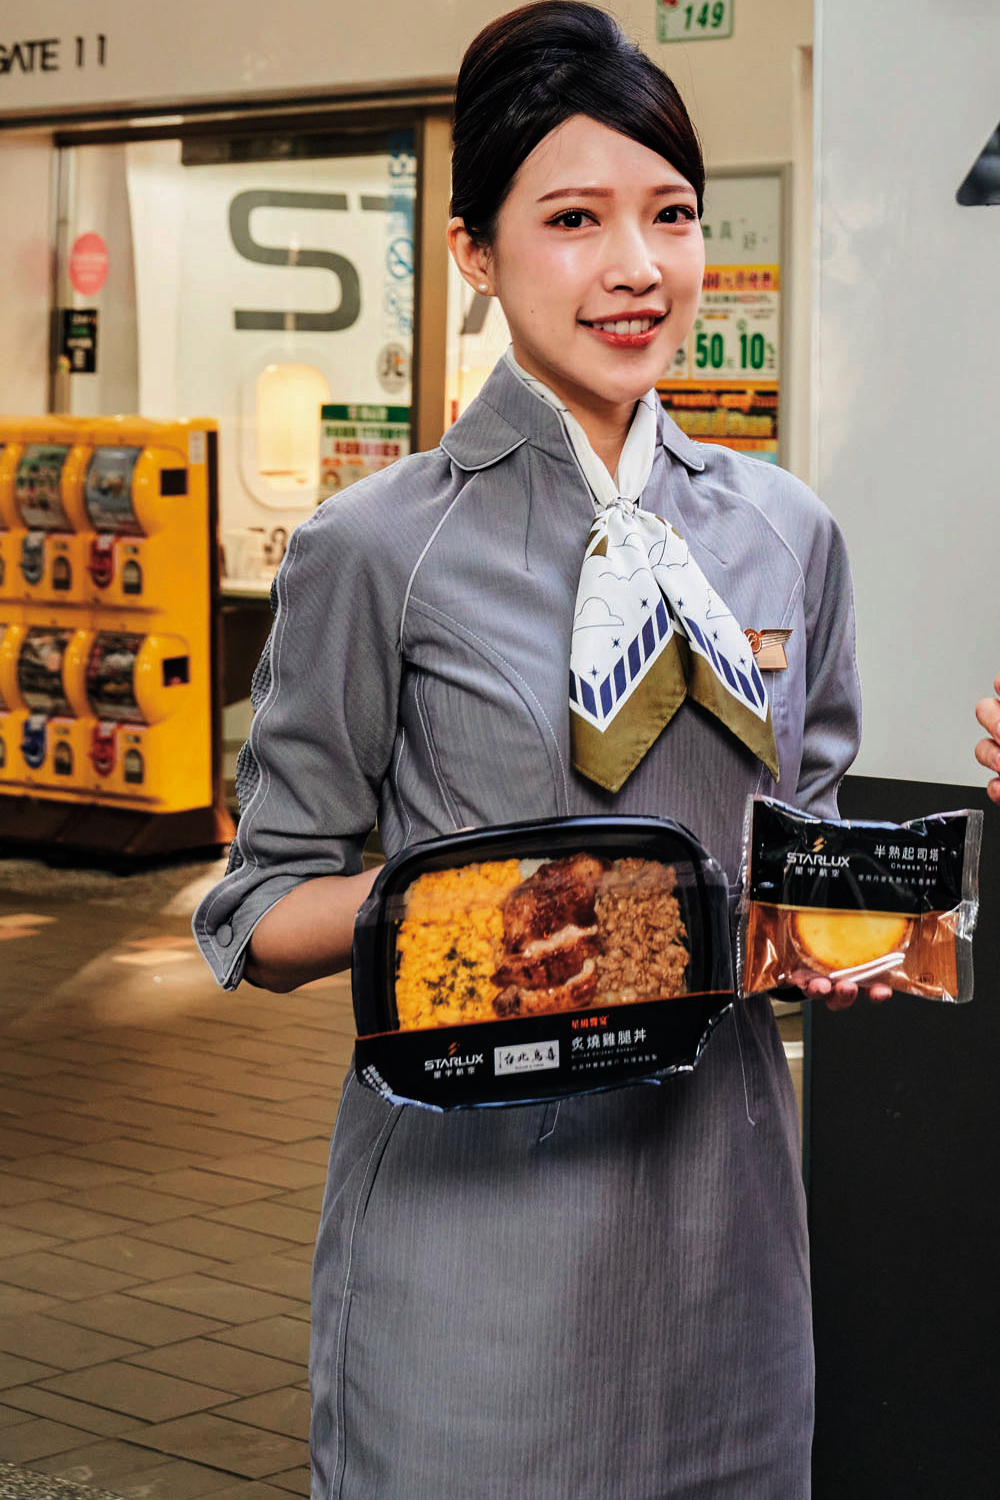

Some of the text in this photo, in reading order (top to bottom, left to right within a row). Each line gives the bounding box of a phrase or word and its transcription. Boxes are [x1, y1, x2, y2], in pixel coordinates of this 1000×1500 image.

[684, 0, 725, 31] 149
[695, 332, 766, 370] 50 10
[786, 851, 850, 868] STARLUX
[873, 844, 939, 862] 半熟起司塔
[424, 1053, 484, 1072] STARLUX
